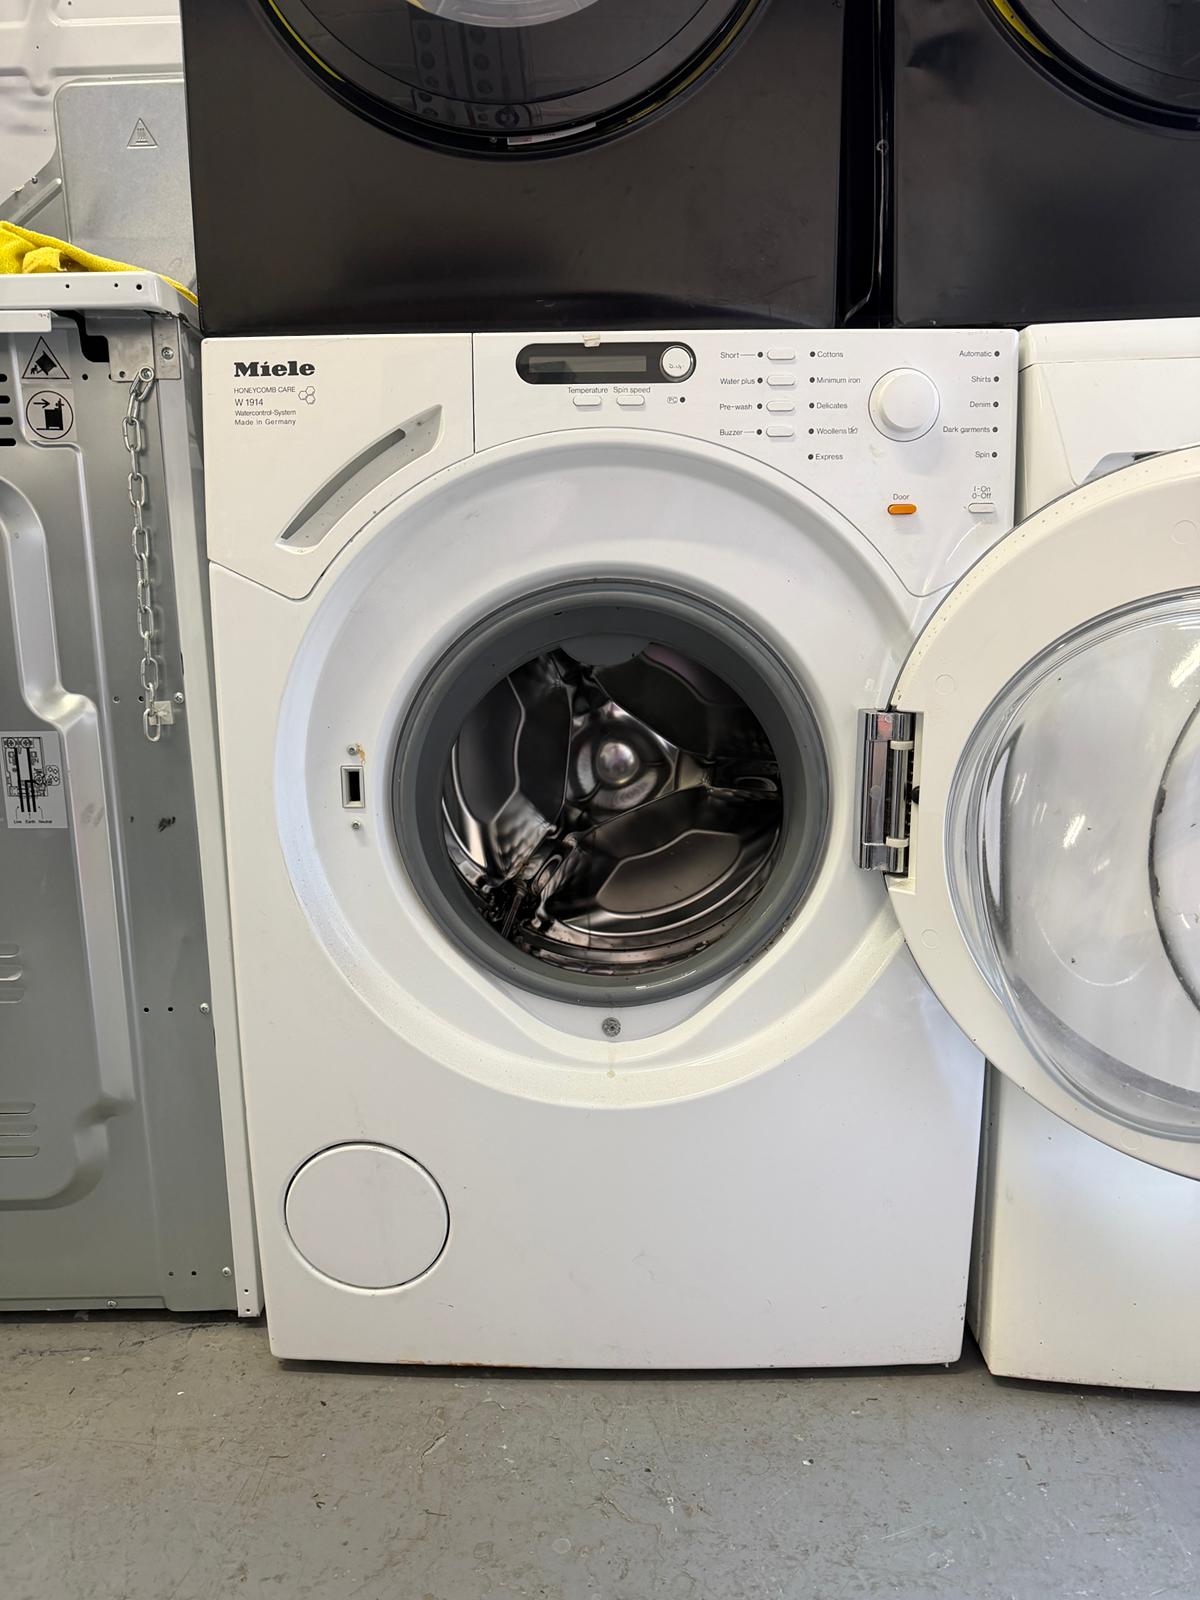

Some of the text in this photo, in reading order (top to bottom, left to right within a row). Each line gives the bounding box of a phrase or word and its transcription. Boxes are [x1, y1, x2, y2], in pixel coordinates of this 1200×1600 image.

[233, 361, 316, 377] Miele
[741, 378, 756, 386] plus
[245, 398, 264, 406] 1914
[960, 426, 991, 434] garments
[815, 453, 844, 462] Express
[975, 451, 990, 459] Spin
